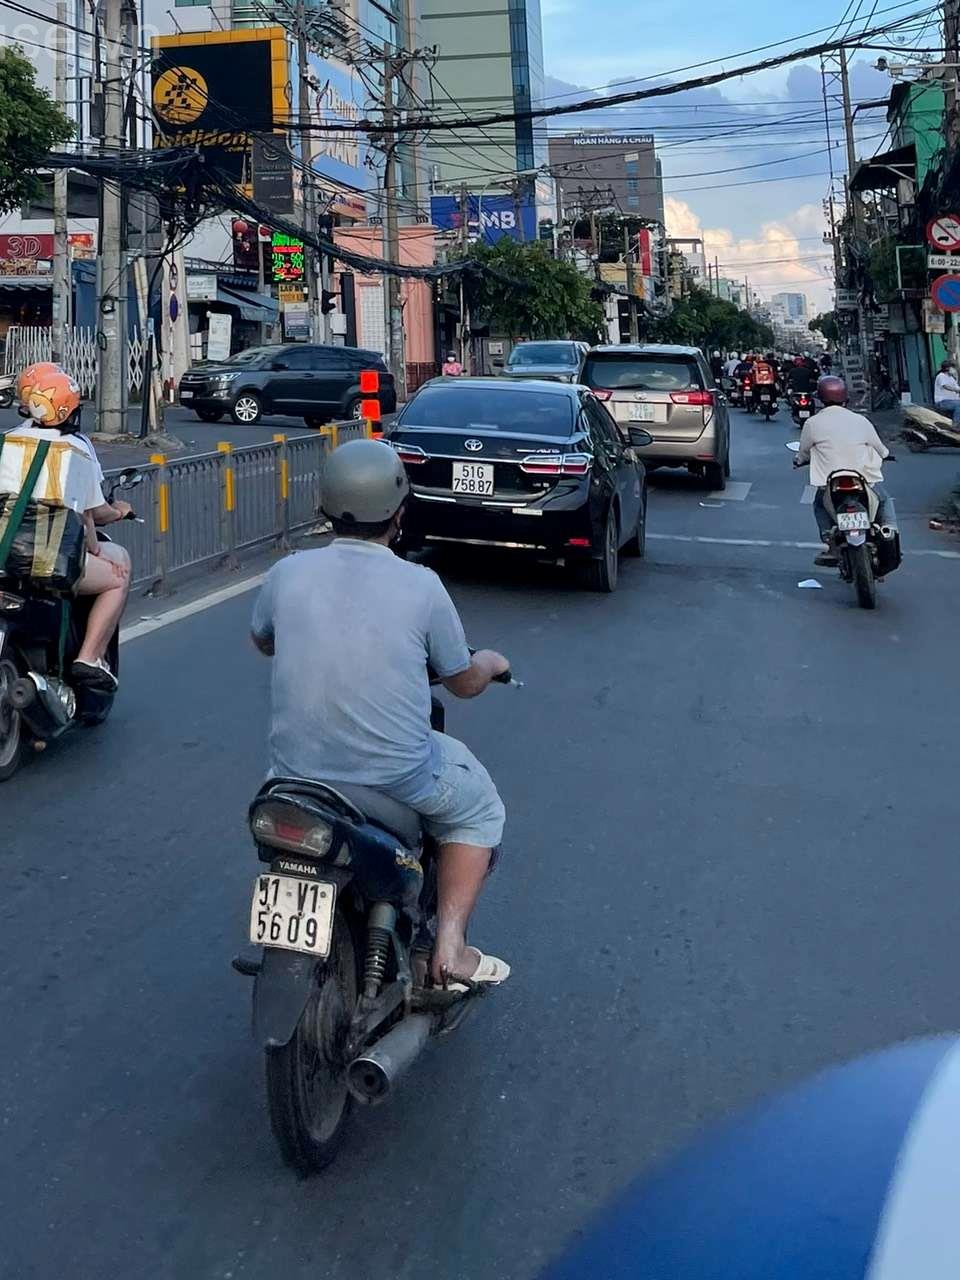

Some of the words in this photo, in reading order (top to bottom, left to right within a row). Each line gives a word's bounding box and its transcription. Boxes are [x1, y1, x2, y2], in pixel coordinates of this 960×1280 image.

[480, 211, 516, 230] MB
[7, 235, 41, 258] 3D
[462, 465, 484, 479] 51G
[454, 478, 492, 494] 758.87
[279, 861, 317, 875] YAMAHA
[257, 911, 319, 948] 5609
